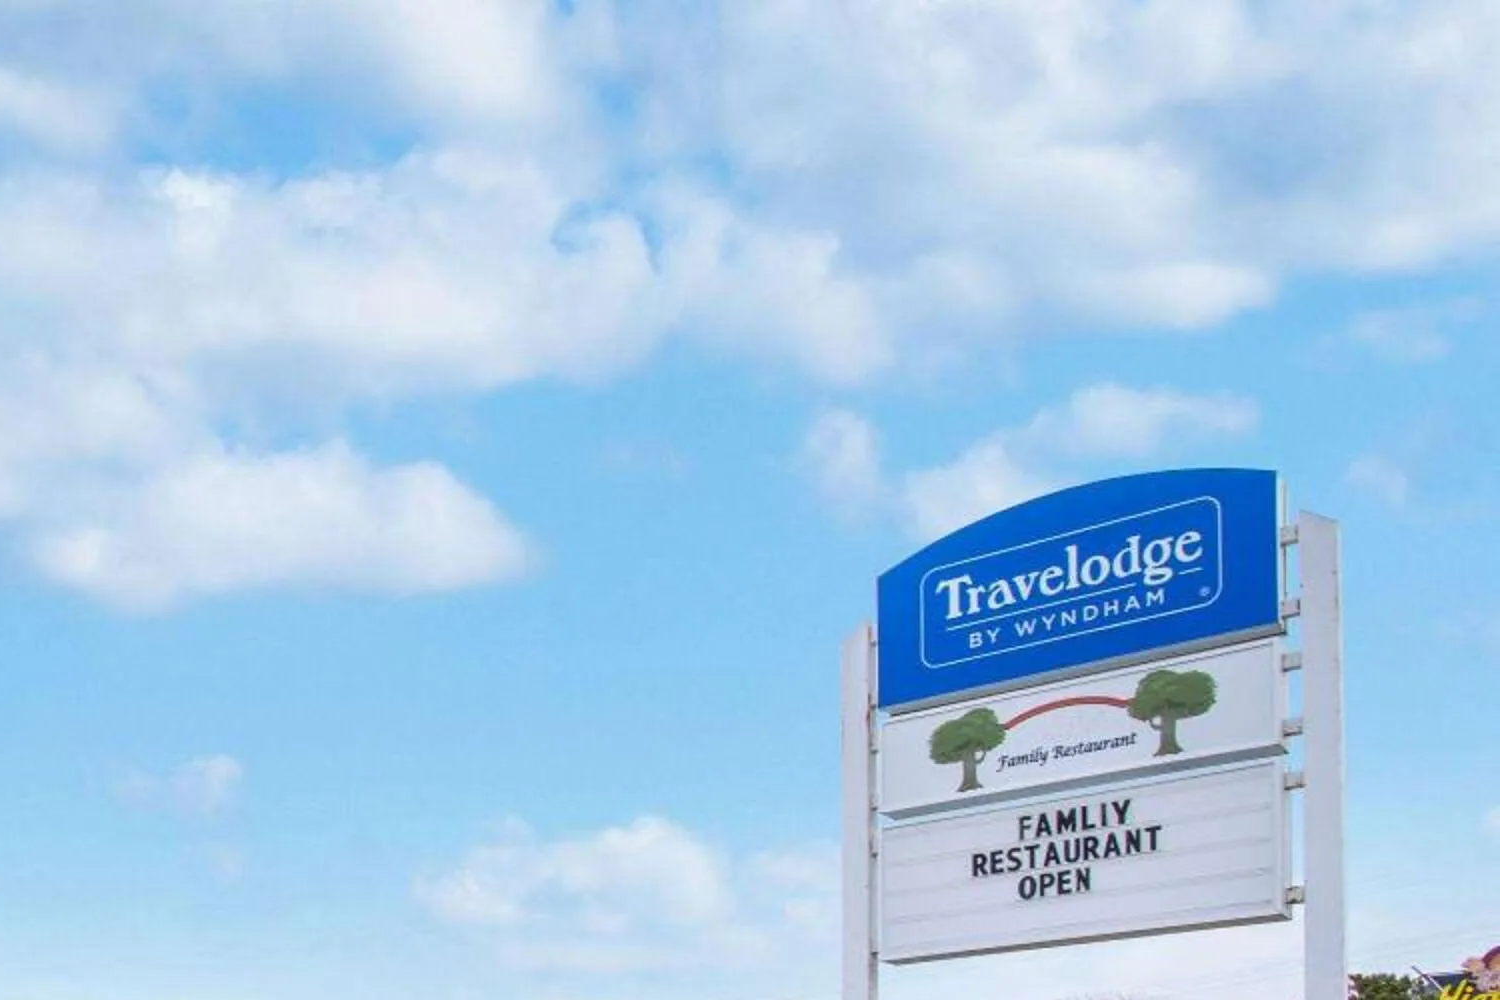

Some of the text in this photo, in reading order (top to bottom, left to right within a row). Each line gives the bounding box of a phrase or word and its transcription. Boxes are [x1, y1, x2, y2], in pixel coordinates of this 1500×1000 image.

[935, 530, 1203, 621] Travelodge
[968, 588, 1166, 650] BY WYNDHAM
[996, 732, 1138, 773] Family Restaurant
[1018, 799, 1132, 842] FAMLIY
[971, 825, 1163, 878] RESTAURANT
[1018, 867, 1092, 901] OPEN
